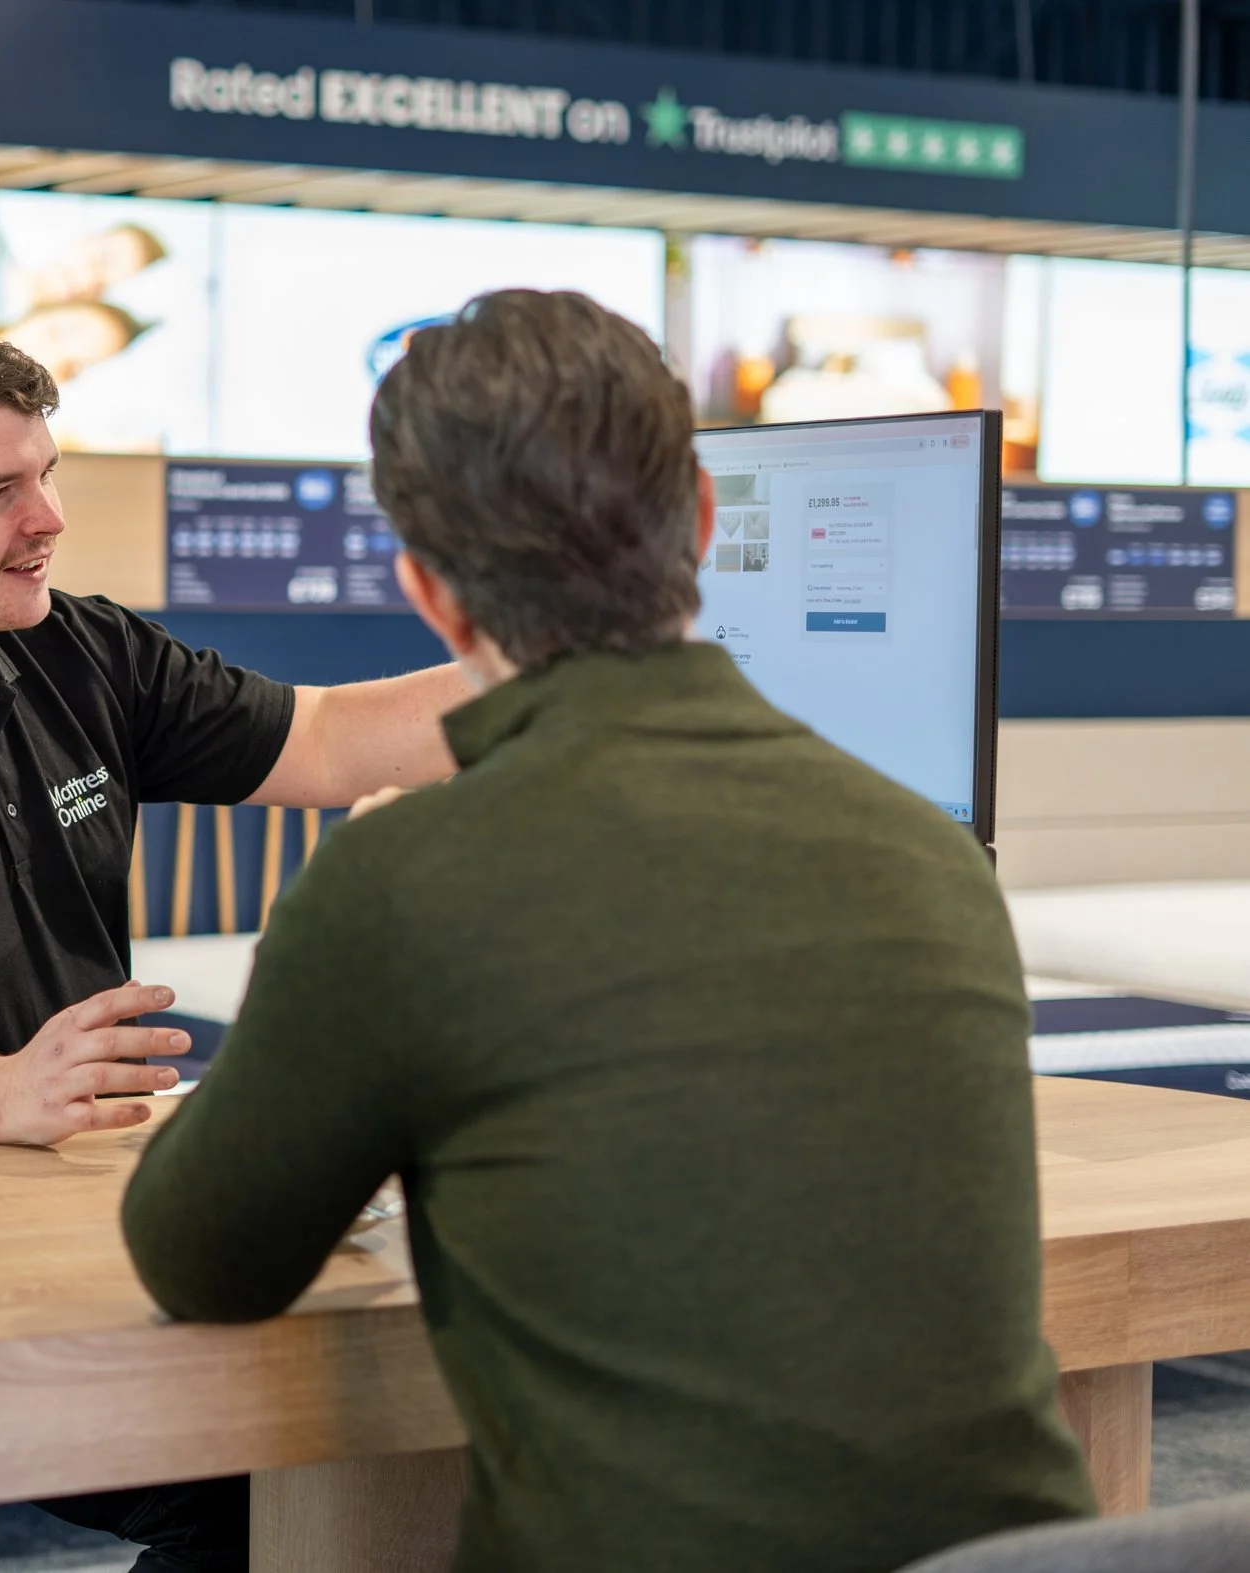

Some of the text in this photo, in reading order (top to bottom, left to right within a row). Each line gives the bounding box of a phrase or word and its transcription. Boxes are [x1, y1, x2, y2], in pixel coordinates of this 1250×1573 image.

[171, 59, 837, 164] Rated EXCELLENT on Trustpilot
[48, 766, 109, 809] Mattress
[58, 793, 107, 828] Online
